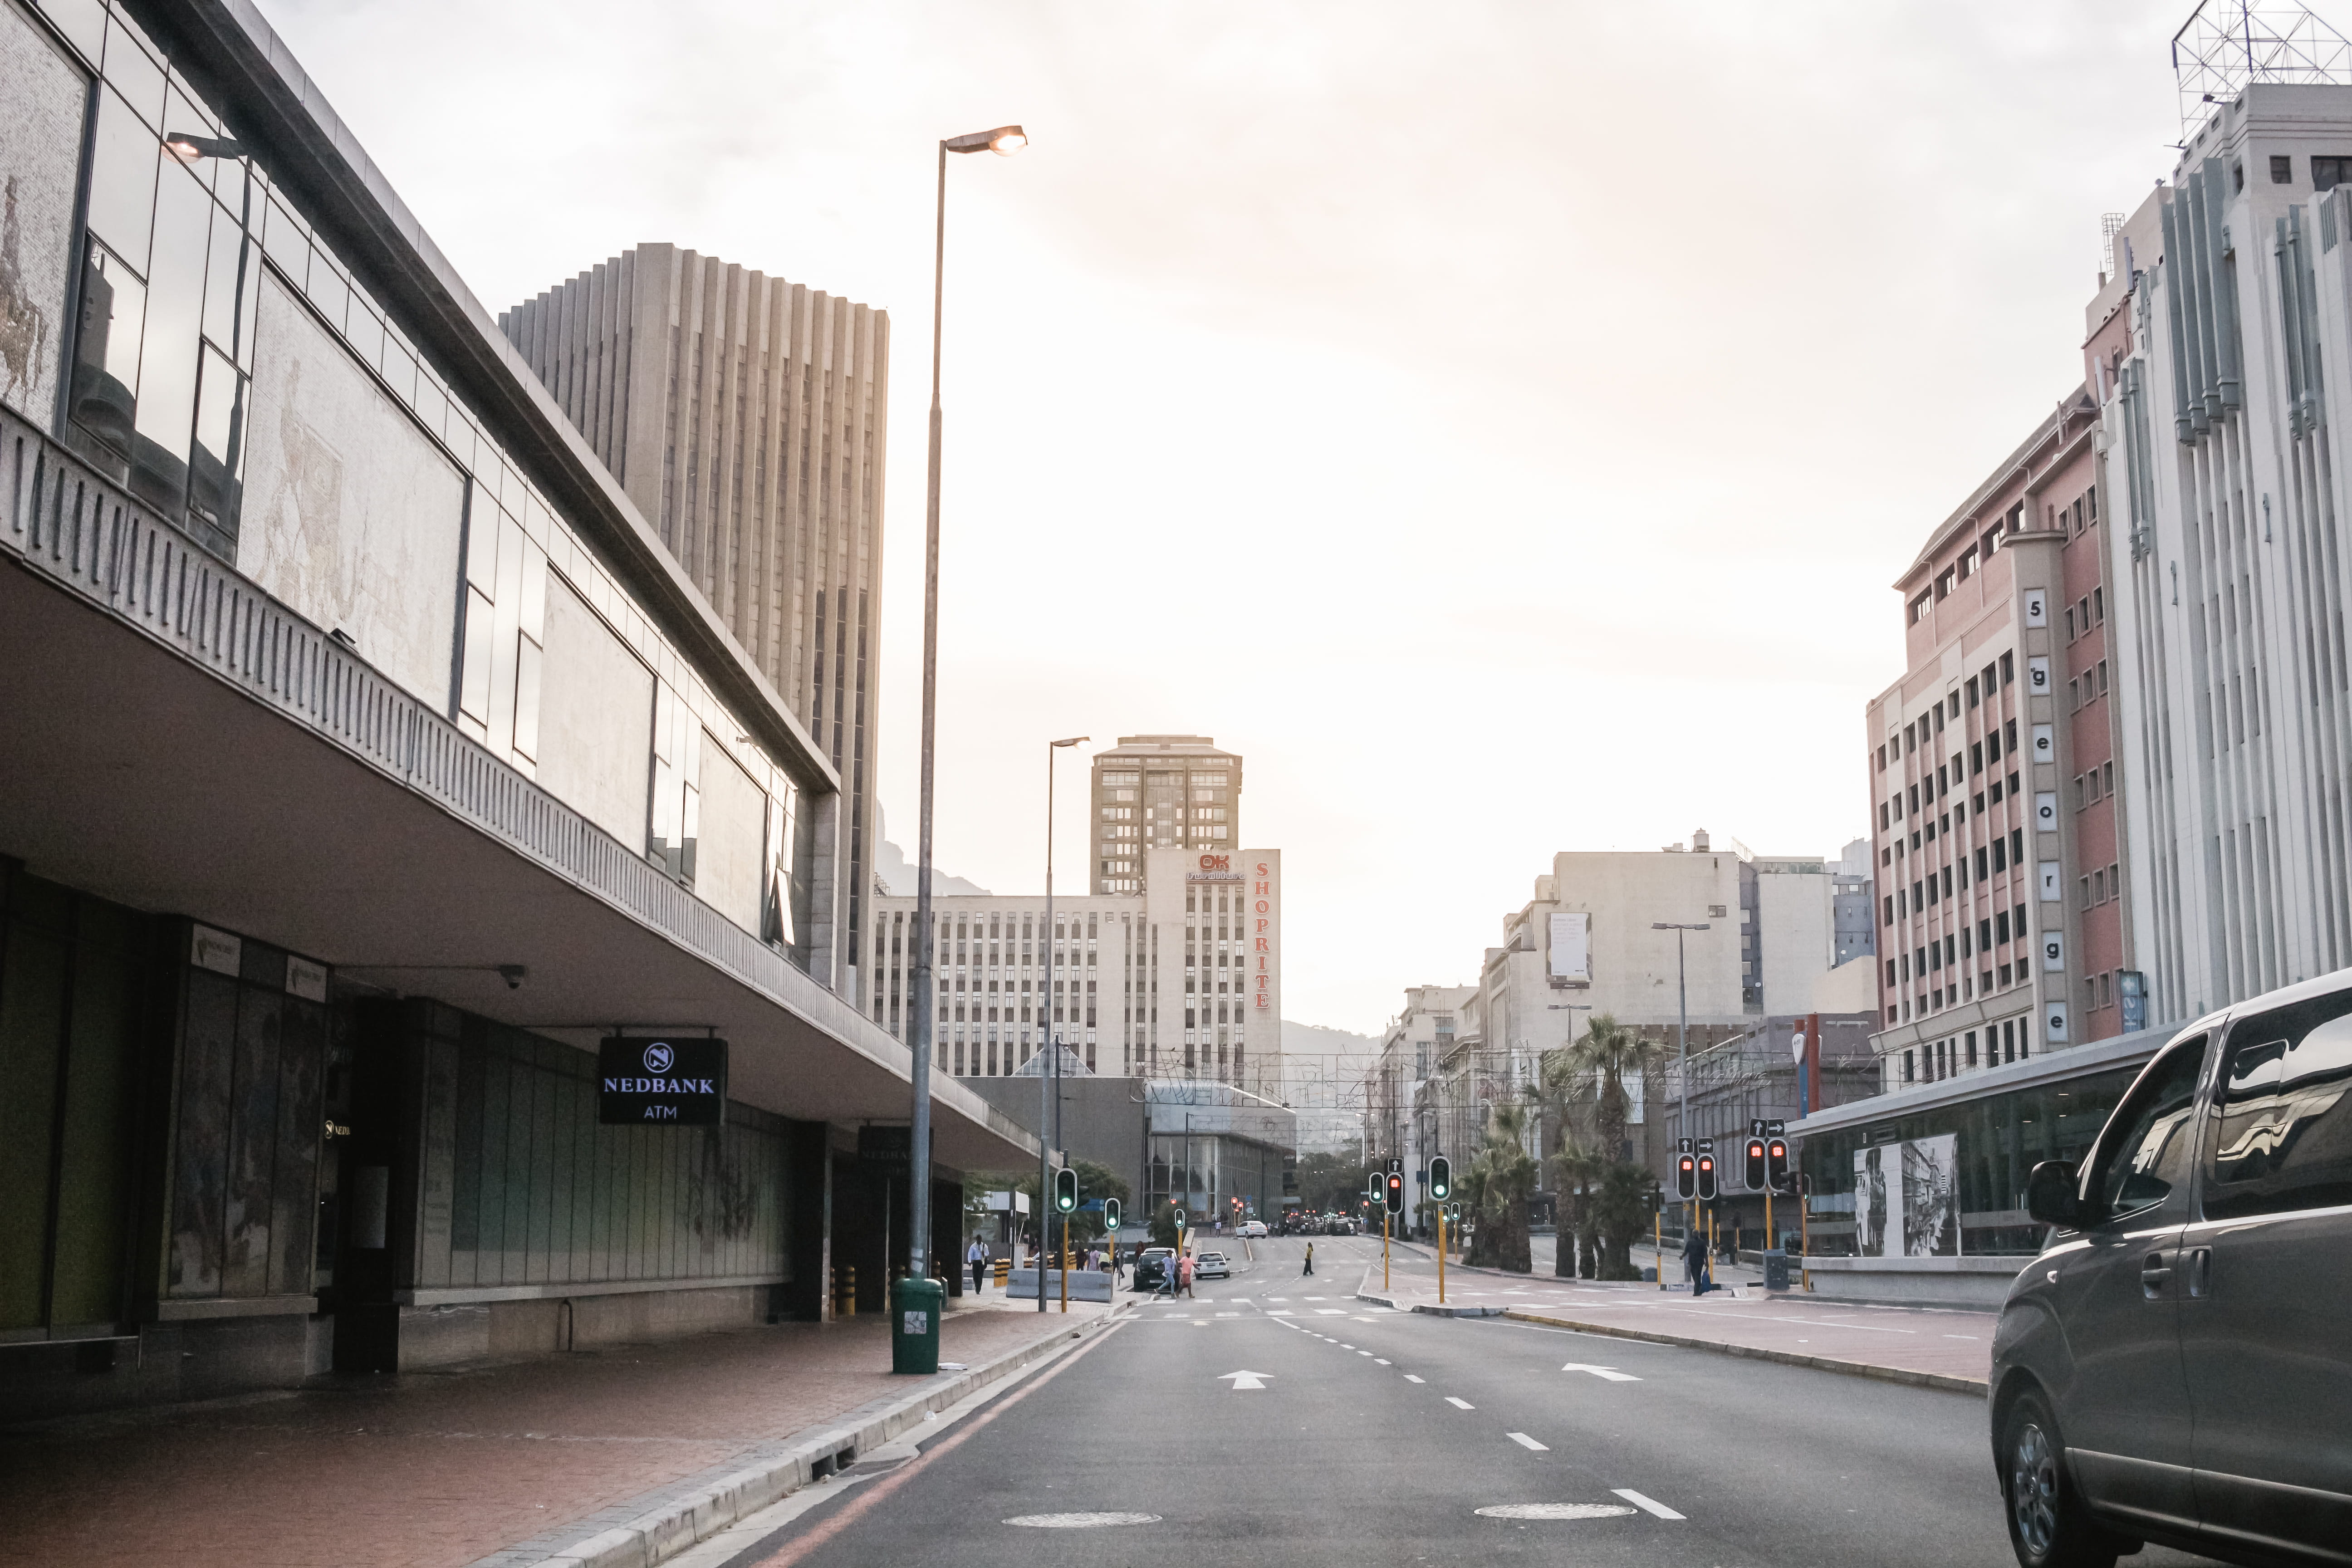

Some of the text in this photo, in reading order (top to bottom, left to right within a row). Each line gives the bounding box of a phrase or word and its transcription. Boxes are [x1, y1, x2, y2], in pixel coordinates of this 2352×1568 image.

[1199, 854, 1230, 870] OK
[1186, 872, 1246, 880] Furniture
[1254, 862, 1270, 1009] SHOPRITE
[603, 1078, 715, 1093] NEDBANK
[644, 1105, 677, 1119] ATM
